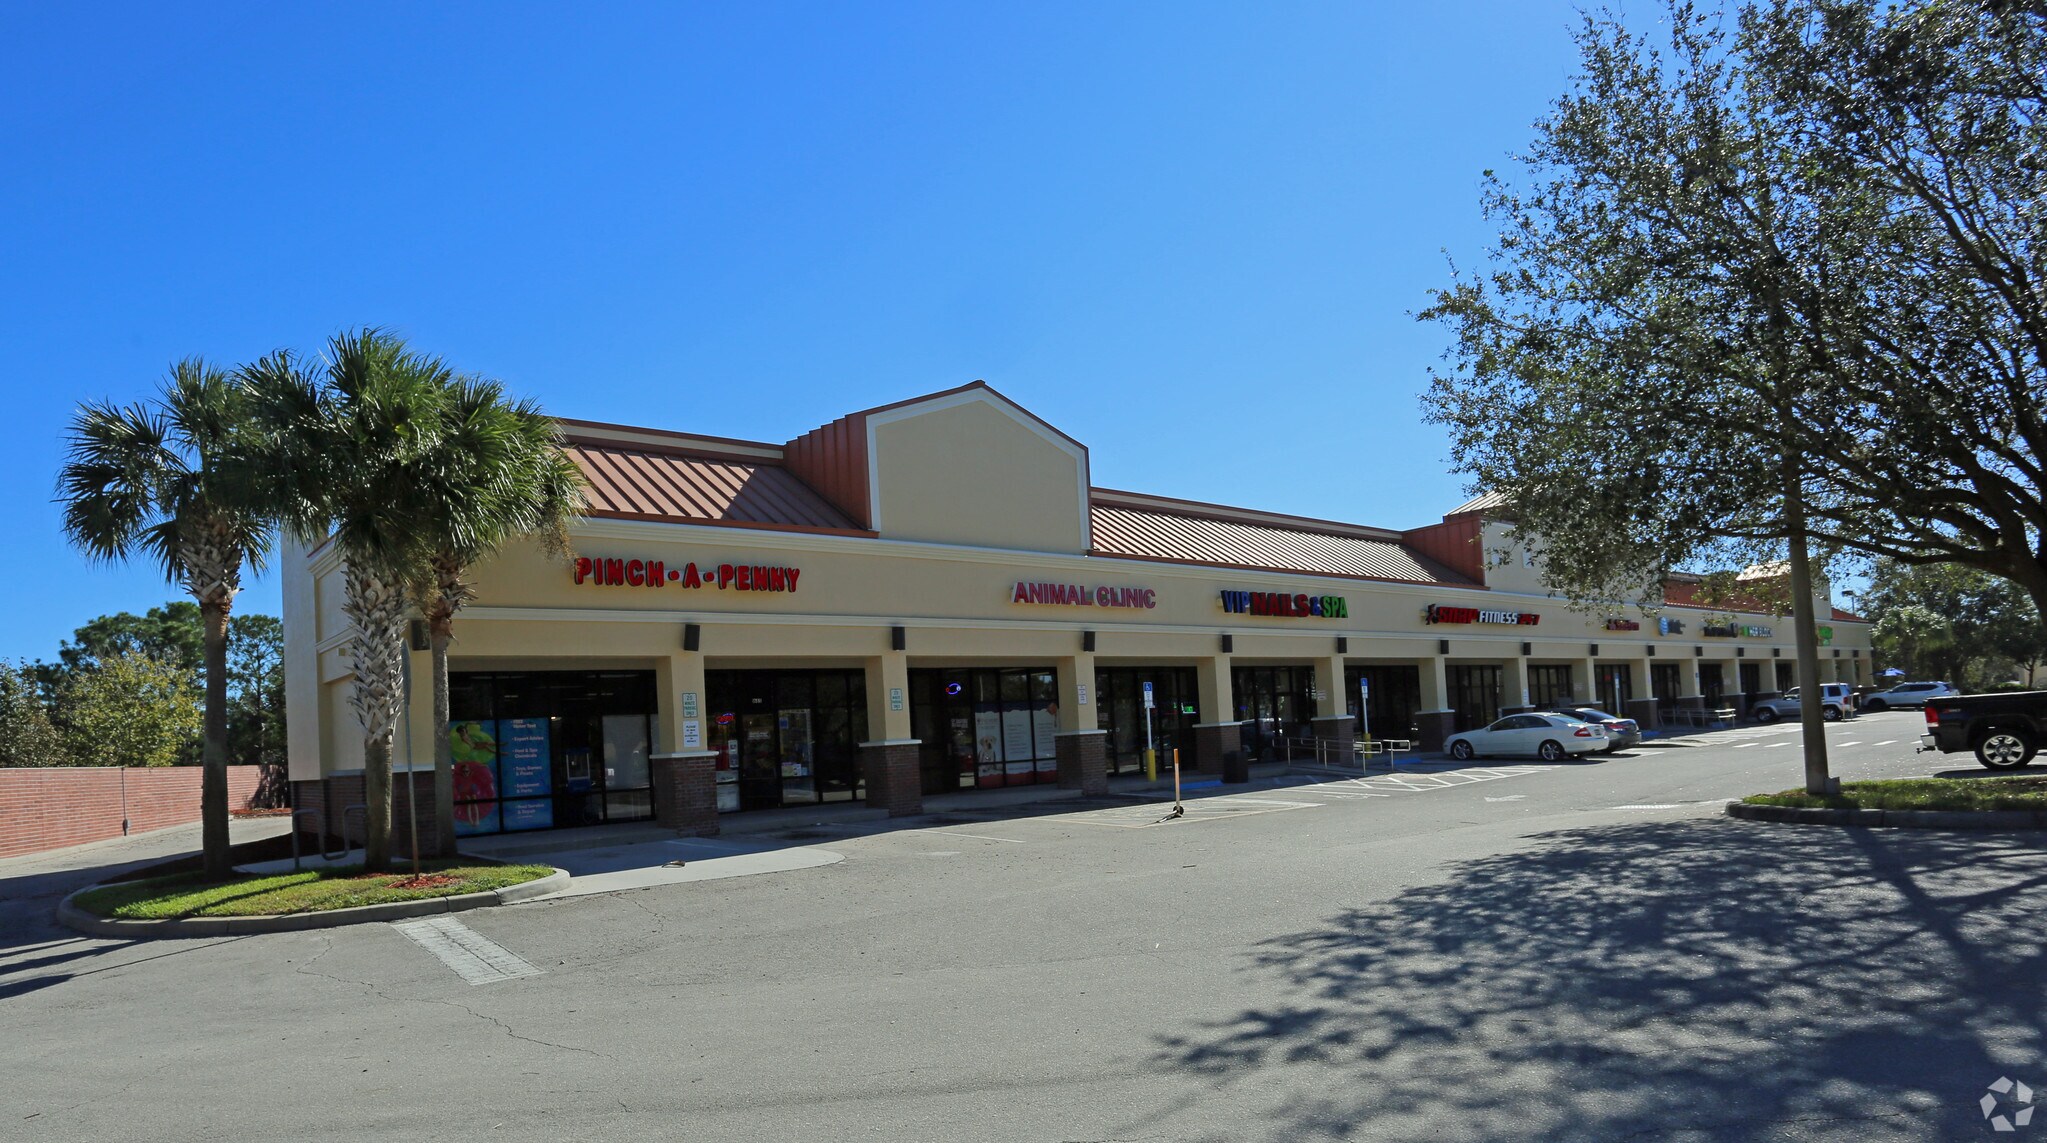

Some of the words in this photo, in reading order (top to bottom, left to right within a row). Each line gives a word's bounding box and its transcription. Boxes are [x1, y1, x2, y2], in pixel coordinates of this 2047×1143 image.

[574, 557, 665, 588] PINCH
[718, 564, 800, 593] PENNY
[1011, 582, 1092, 606] ANIMAL
[1093, 586, 1156, 609] CLINIC
[1221, 590, 1250, 613] VIP
[1249, 591, 1309, 617] NAILS
[1320, 595, 1348, 618] SPA
[1479, 610, 1518, 625] FITNESS
